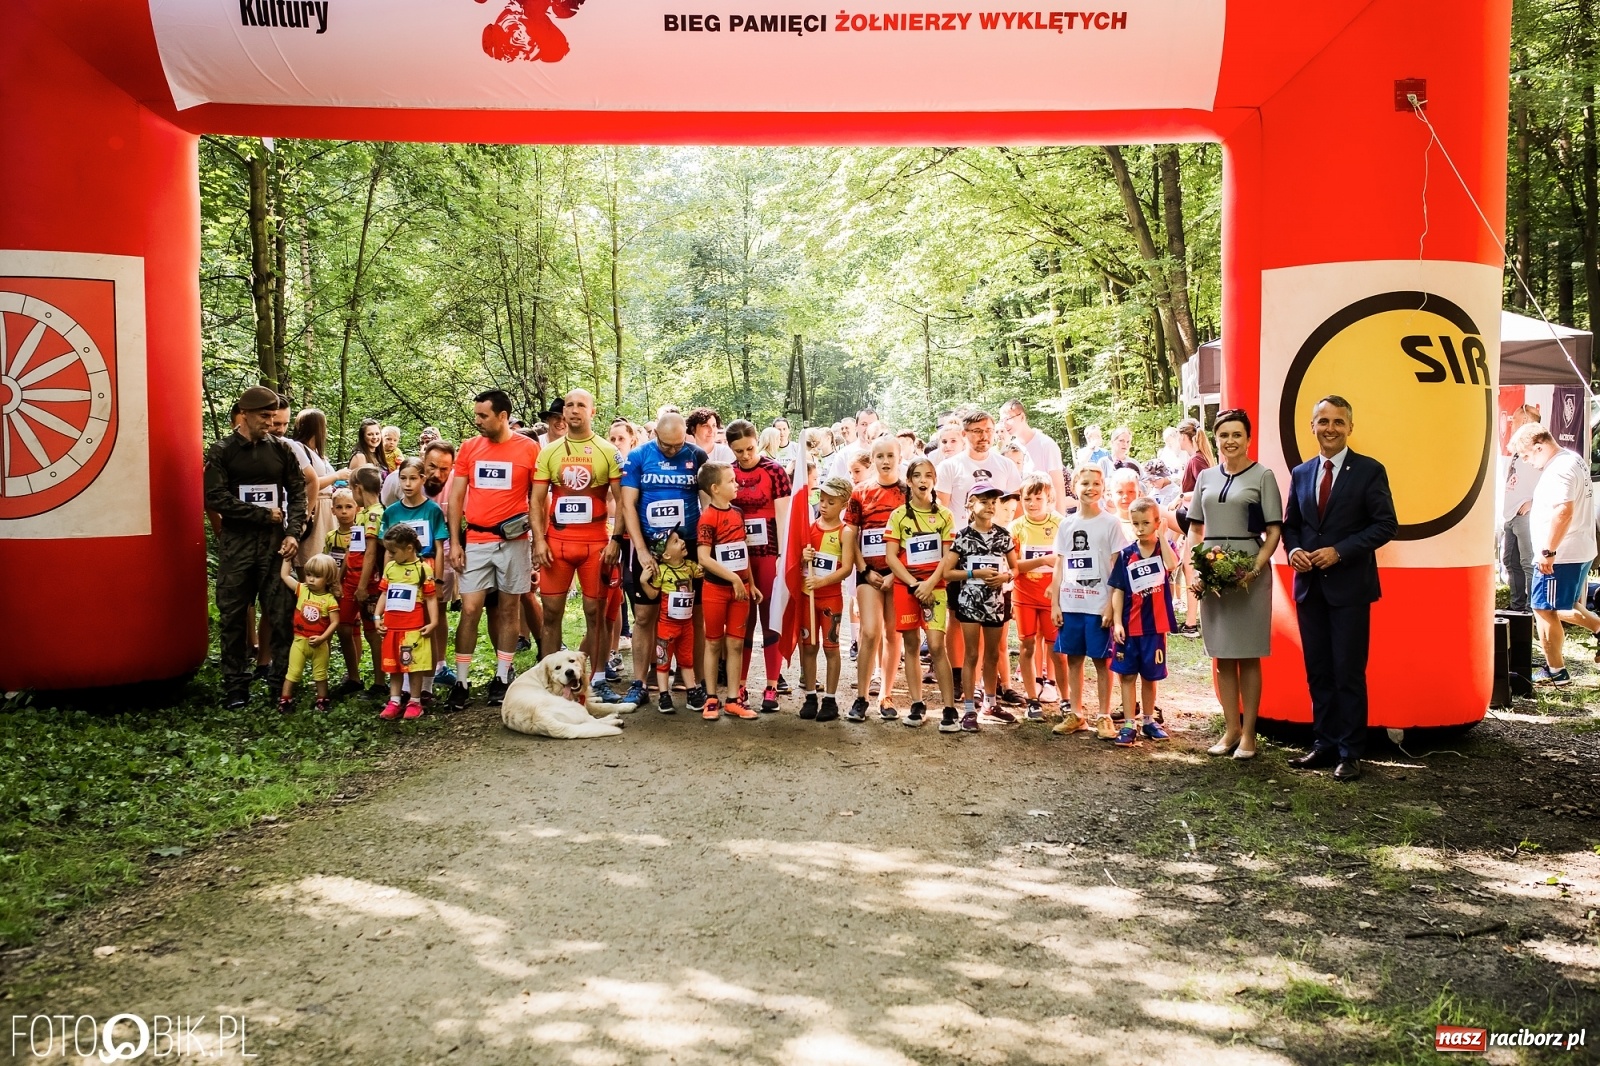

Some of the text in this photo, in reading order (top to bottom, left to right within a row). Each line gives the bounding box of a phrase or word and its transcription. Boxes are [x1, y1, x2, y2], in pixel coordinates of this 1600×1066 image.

[239, 0, 329, 34] Kultury
[663, 10, 1128, 37] BIEG PAMIĘCI ŻOŁNIERZY WYKLĘTYCH
[485, 469, 499, 478] 76
[252, 492, 267, 501] 12
[565, 503, 579, 512] 80
[655, 506, 675, 516] 112
[869, 534, 883, 544] 83
[917, 541, 931, 551] 97
[728, 550, 741, 559] 82
[1071, 558, 1084, 568] 16
[1137, 565, 1152, 576] 89
[391, 589, 404, 598] 77
